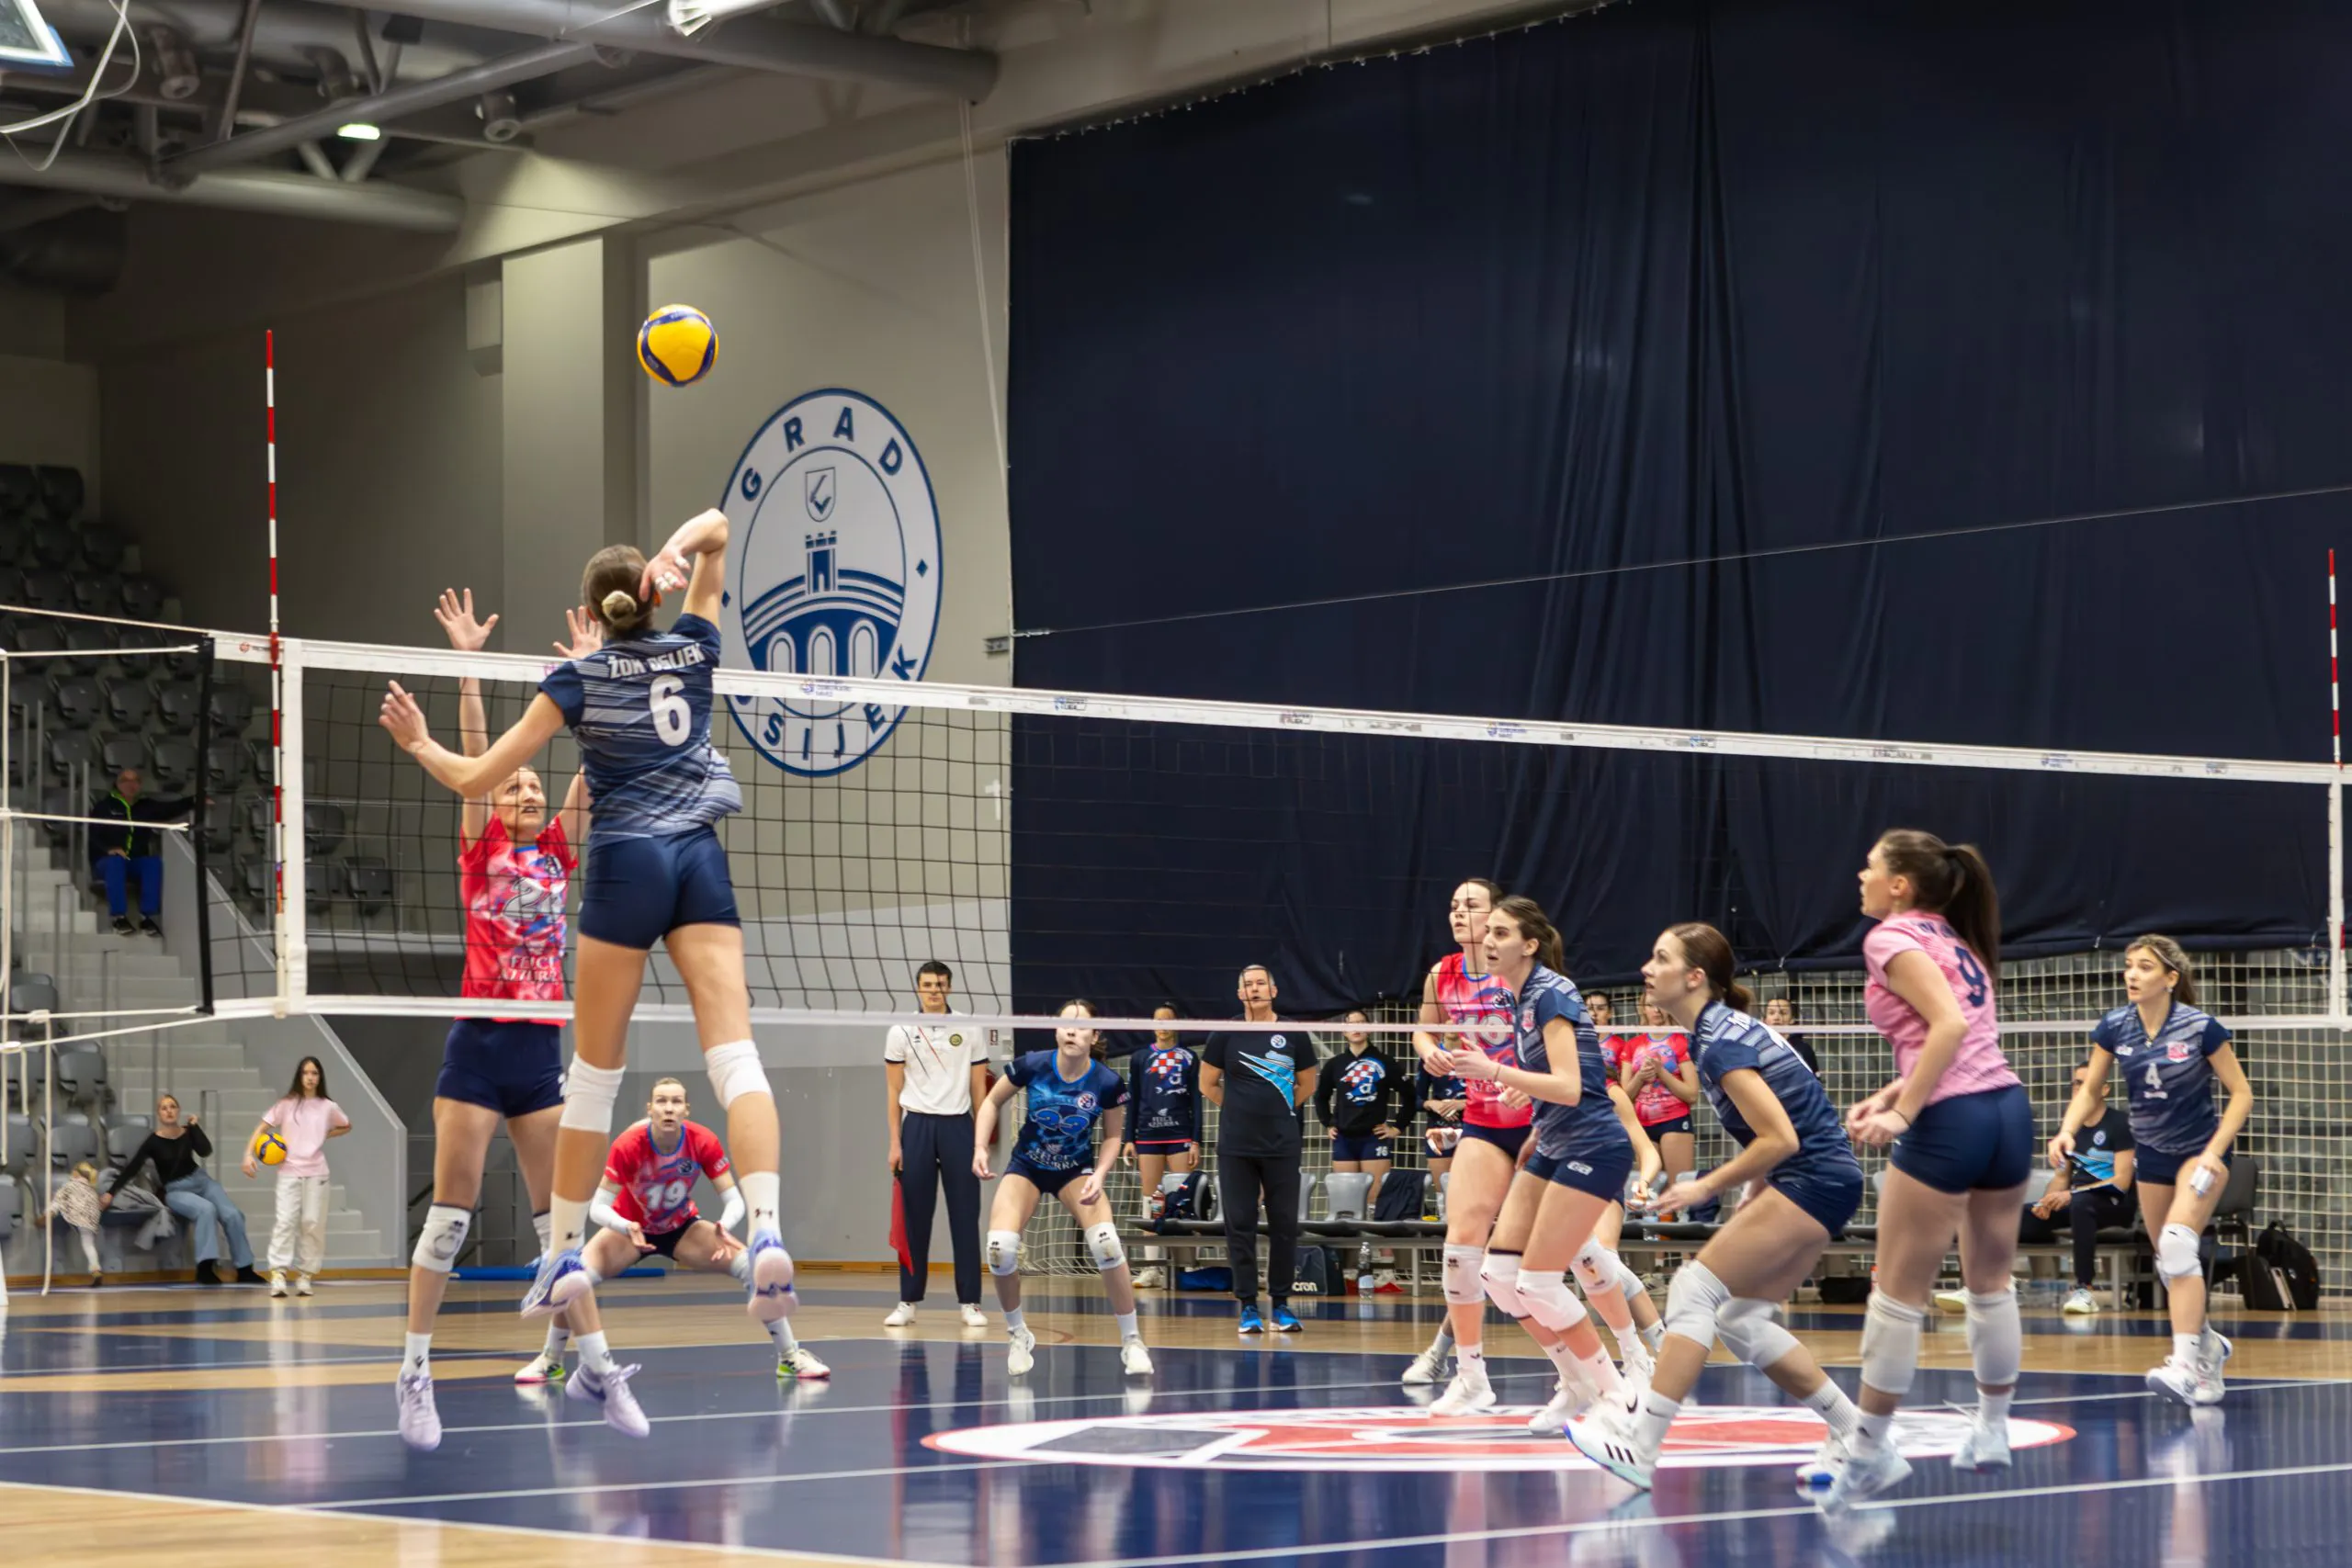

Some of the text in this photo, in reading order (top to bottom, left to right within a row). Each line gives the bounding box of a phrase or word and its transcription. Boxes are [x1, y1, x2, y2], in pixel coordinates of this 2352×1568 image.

[741, 406, 904, 502] GRAD
[649, 673, 692, 746] 6
[735, 643, 918, 761] SIJEK
[1954, 945, 1988, 1008] 9
[2145, 1062, 2163, 1090] 4
[647, 1179, 687, 1211] 19
[1291, 1281, 1317, 1292] cron
